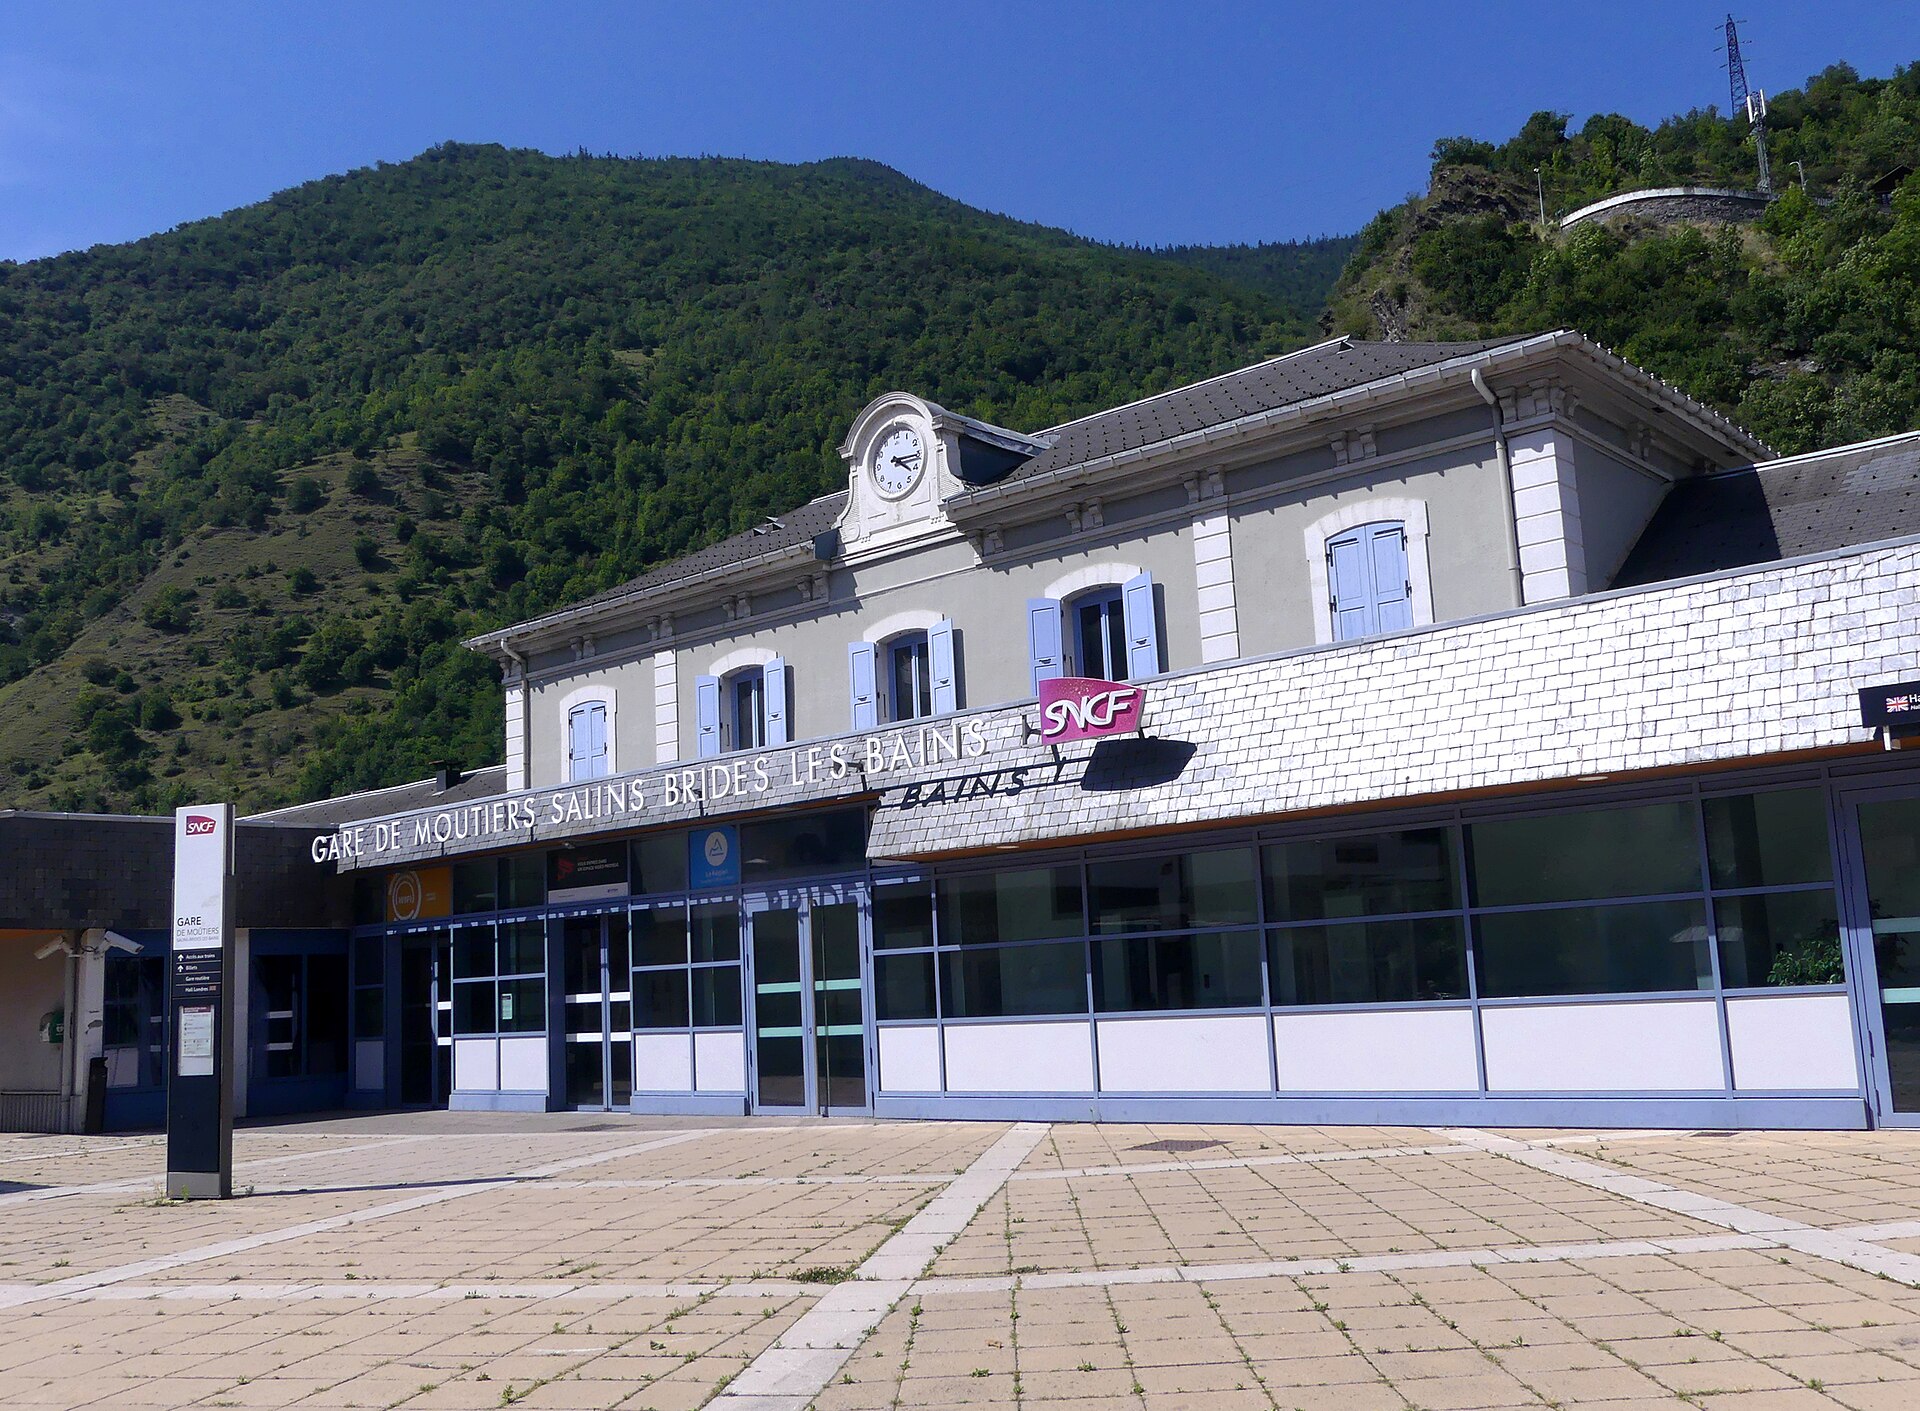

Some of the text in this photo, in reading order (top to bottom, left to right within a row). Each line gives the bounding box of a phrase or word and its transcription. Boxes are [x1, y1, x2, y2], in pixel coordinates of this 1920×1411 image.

[893, 431, 900, 440] 12
[916, 450, 921, 458] 3
[906, 475, 912, 484] 5
[1043, 689, 1138, 736] SNCF
[311, 718, 988, 863] GARE DE MOUTIERS SALINS BRIDES LES BAINS
[186, 821, 215, 834] SNCF
[177, 916, 202, 927] GARE
[176, 926, 219, 937] DE MOÛTIERS
